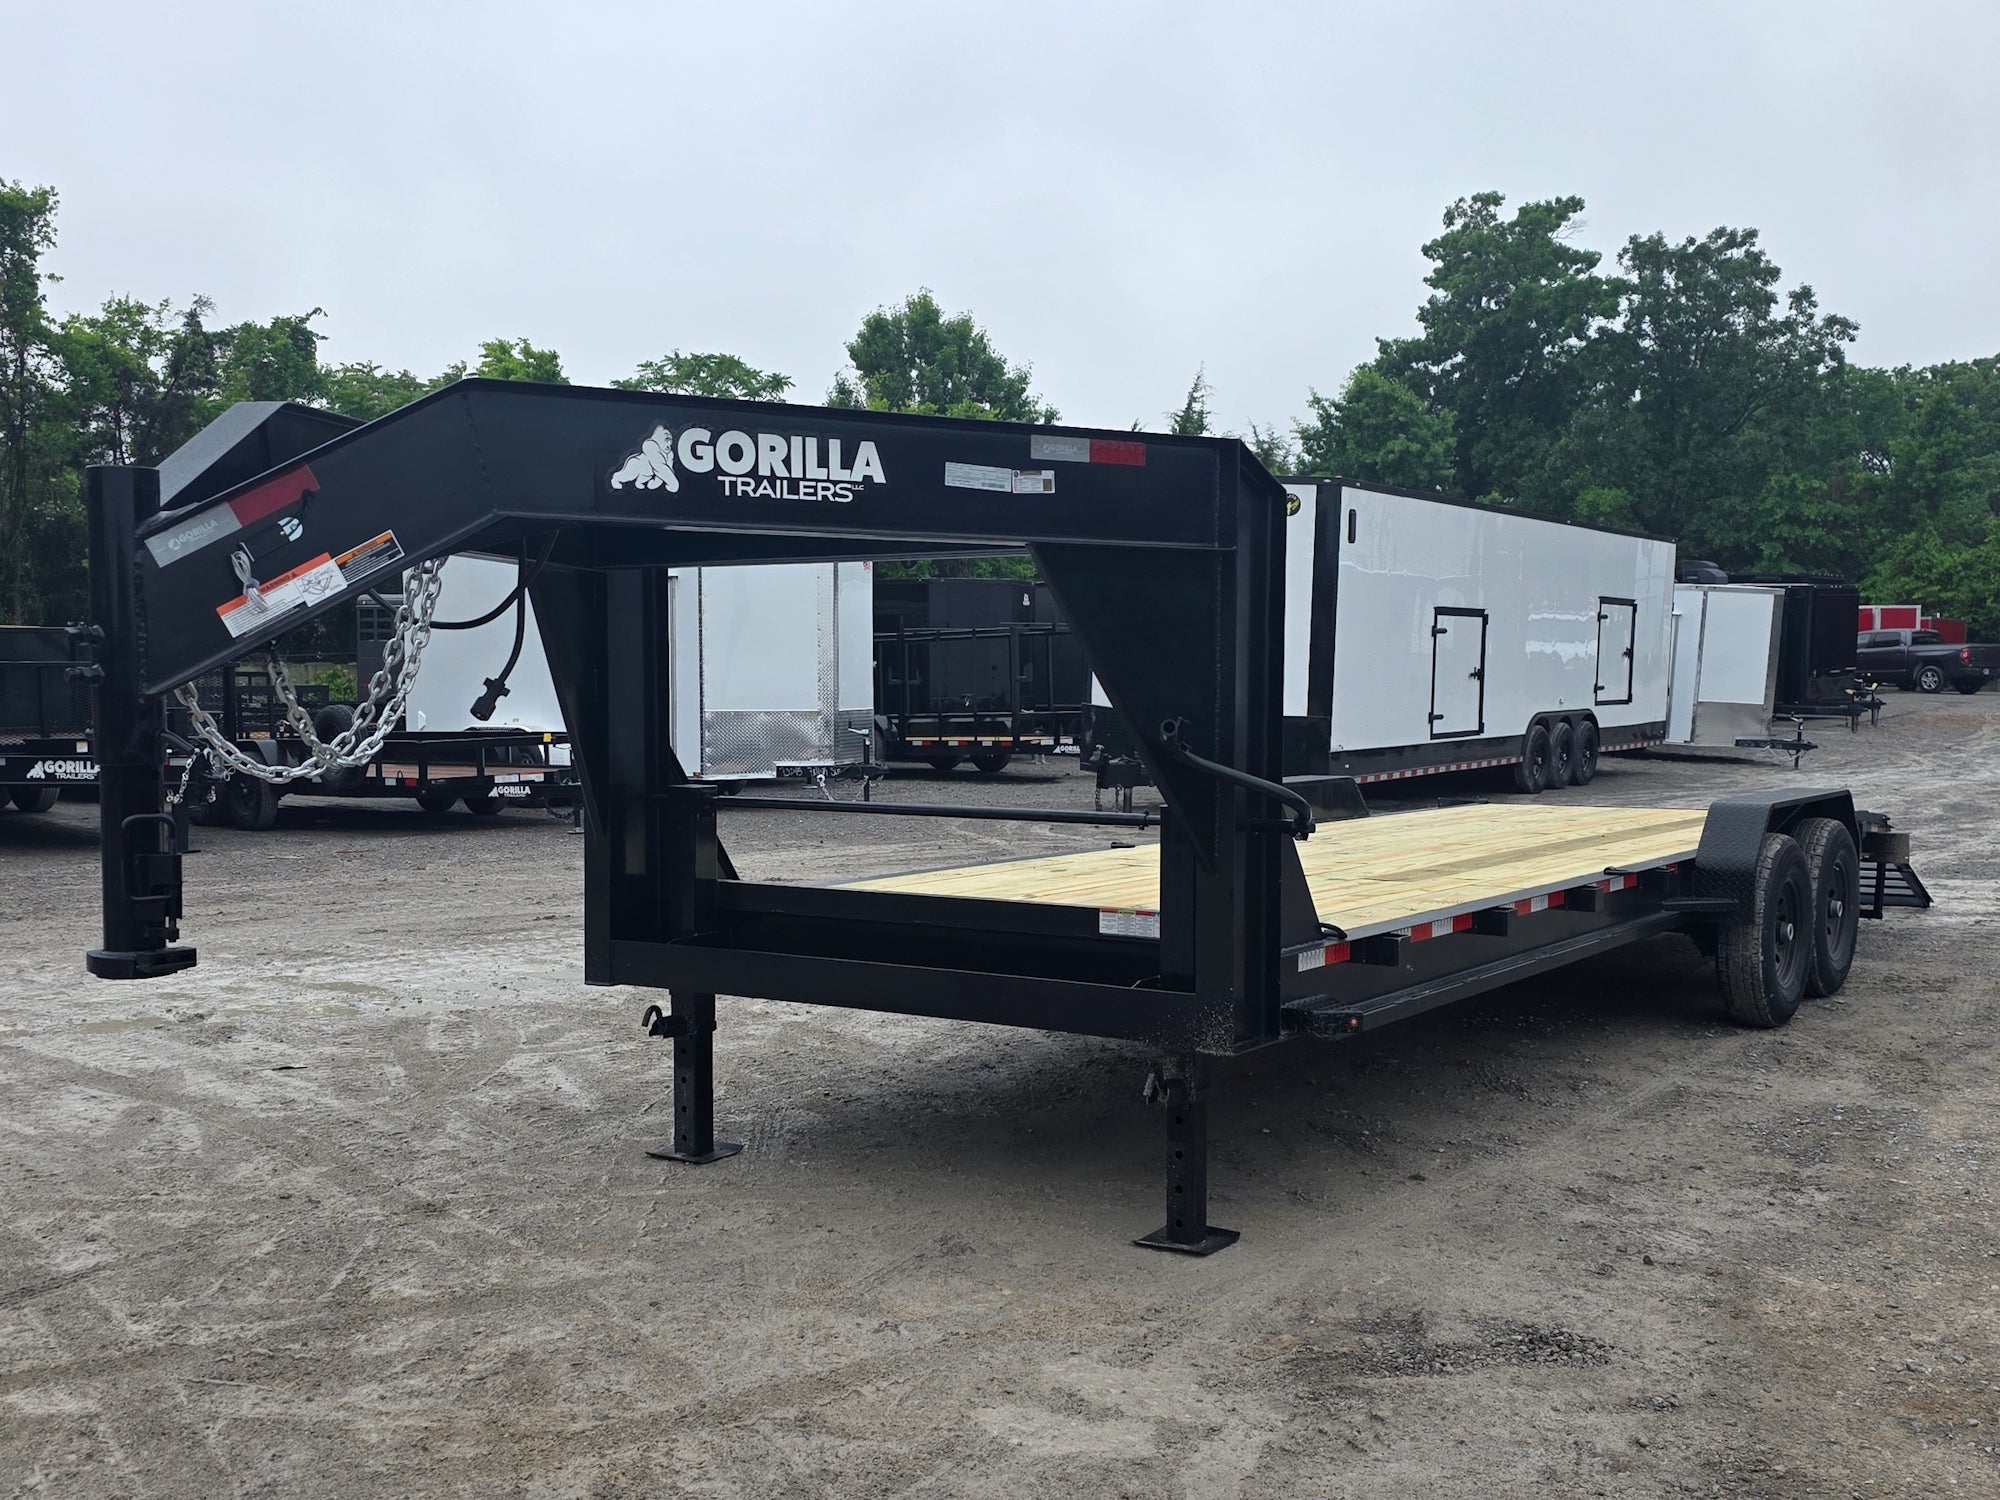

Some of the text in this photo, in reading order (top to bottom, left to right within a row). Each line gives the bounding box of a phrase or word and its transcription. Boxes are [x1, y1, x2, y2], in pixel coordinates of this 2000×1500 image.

[678, 427, 887, 484] GORILLA
[717, 475, 853, 503] TRAILERS
[179, 519, 218, 543] GORILLA
[259, 574, 291, 594] WARNING
[498, 786, 531, 794] GORILLA
